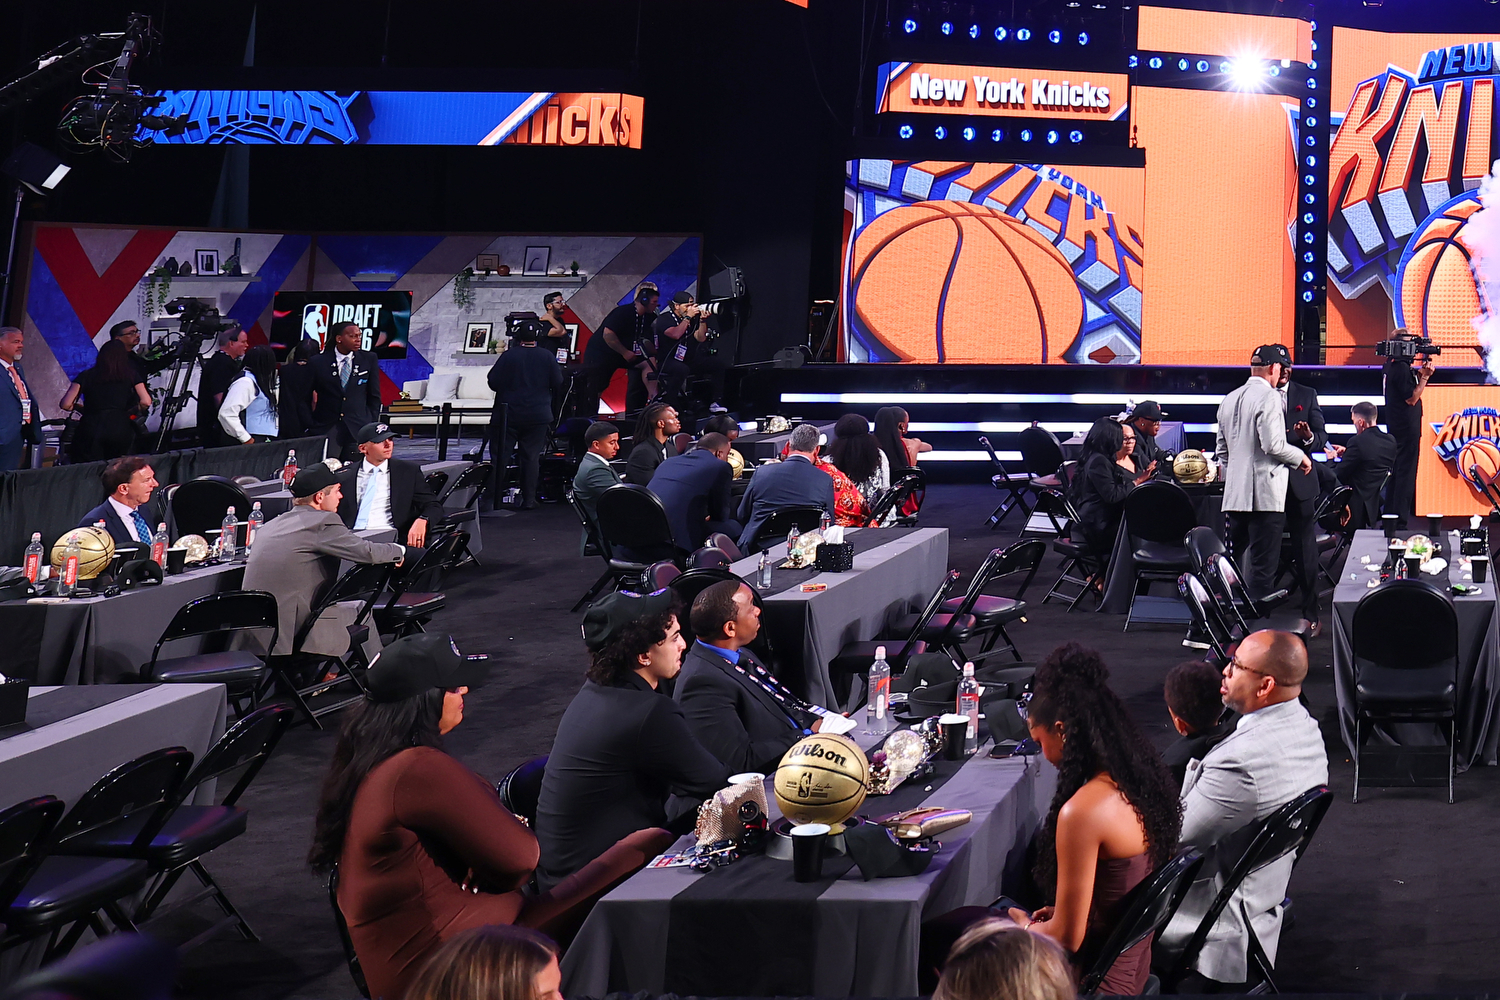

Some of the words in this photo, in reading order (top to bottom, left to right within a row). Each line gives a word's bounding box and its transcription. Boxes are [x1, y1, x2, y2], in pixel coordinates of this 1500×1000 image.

[1419, 42, 1494, 78] NEW
[909, 72, 967, 101] New
[973, 76, 1026, 104] York
[1031, 78, 1111, 108] Knicks
[504, 97, 631, 146] nicks
[332, 304, 383, 328] DRAFT
[789, 743, 847, 767] Wilson
